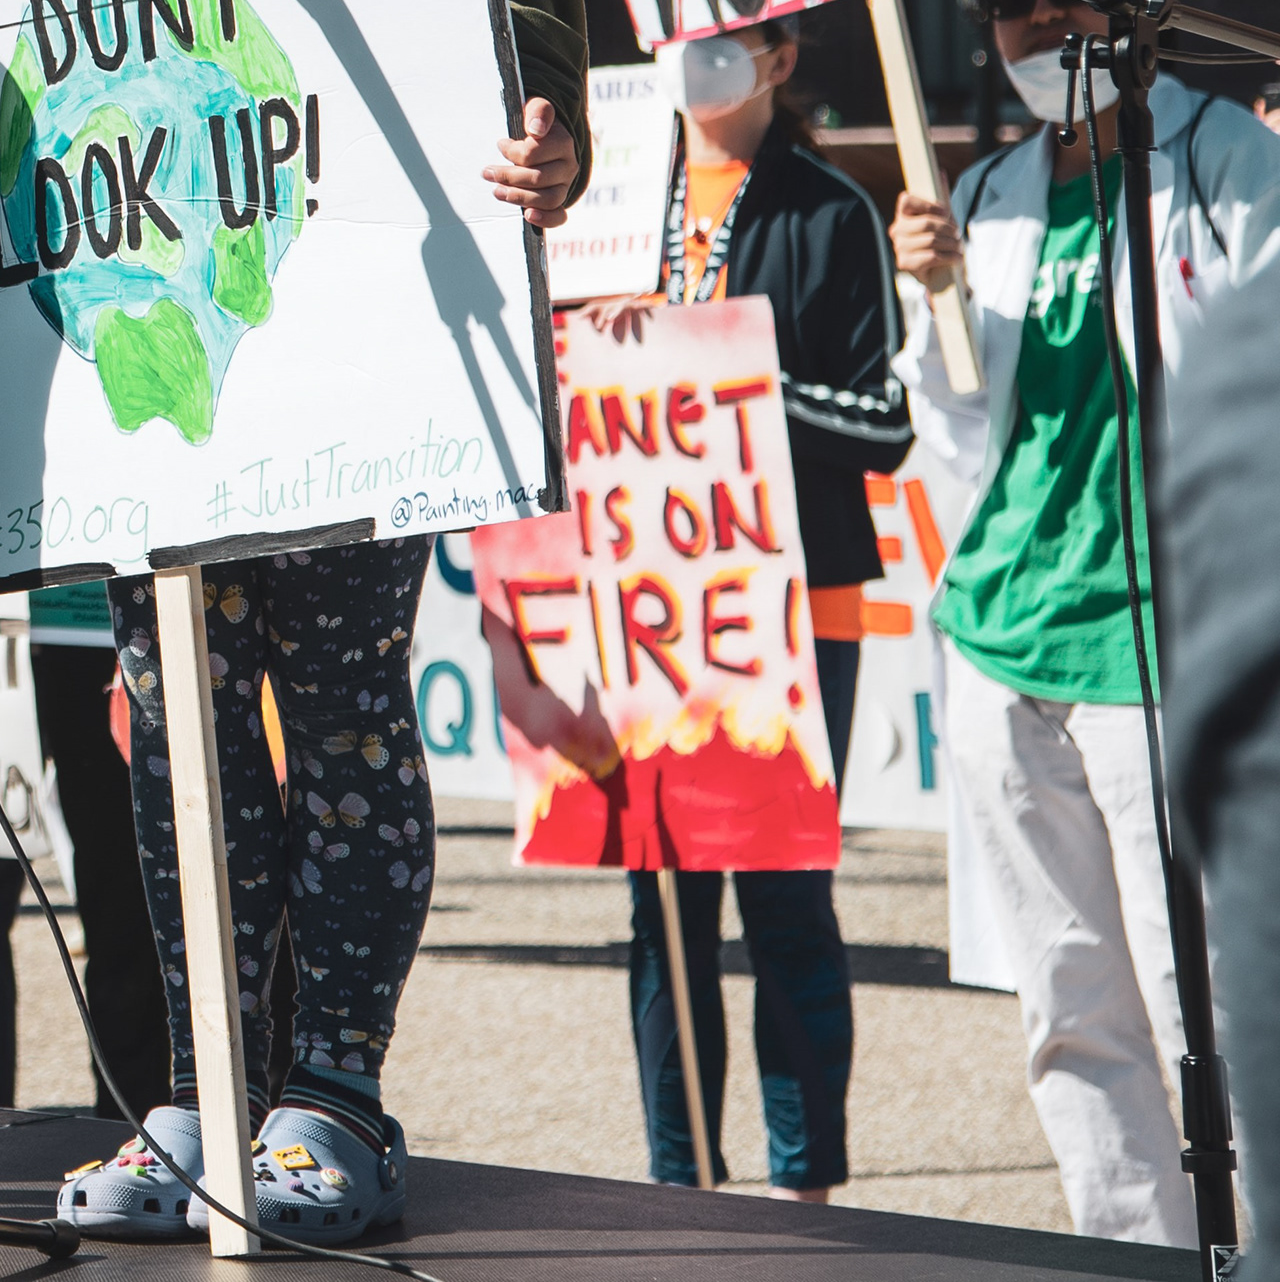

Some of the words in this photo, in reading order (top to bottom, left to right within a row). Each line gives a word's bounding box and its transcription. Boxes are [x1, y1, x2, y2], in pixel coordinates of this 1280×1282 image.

[209, 94, 321, 228] UP!
[207, 418, 484, 529] #JustTransition
[576, 485, 635, 562] IS
[663, 473, 783, 559] ON
[500, 566, 804, 712] FIRE!
